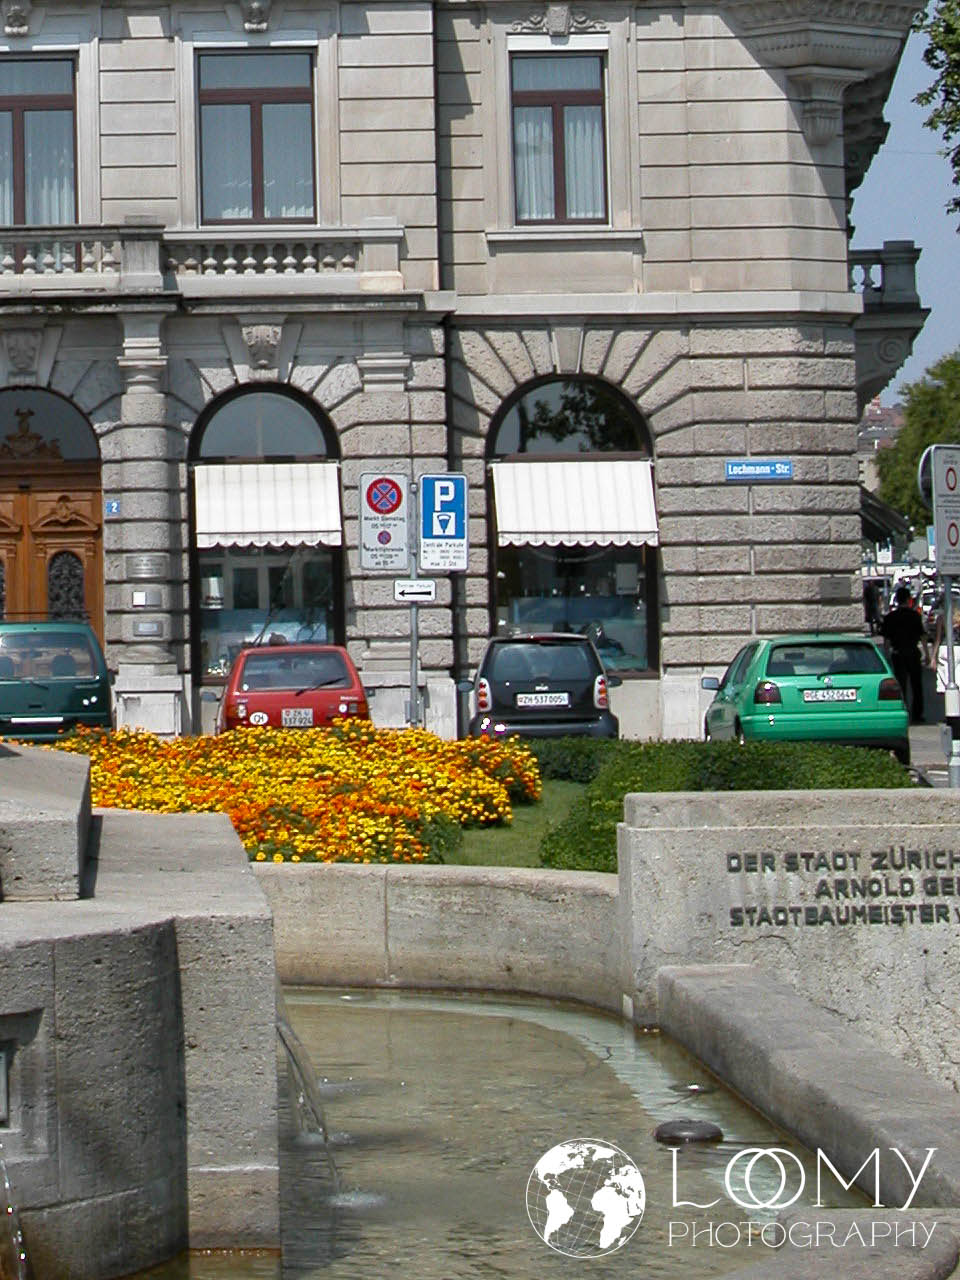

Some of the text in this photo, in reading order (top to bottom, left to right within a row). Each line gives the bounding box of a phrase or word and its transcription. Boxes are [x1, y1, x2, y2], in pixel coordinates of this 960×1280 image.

[111, 502, 118, 512] 2
[435, 481, 455, 511] P
[727, 852, 776, 872] DER
[784, 851, 862, 872] STADT
[815, 877, 915, 900] ARNOLD
[730, 903, 950, 926] STADTBAUMEISTER
